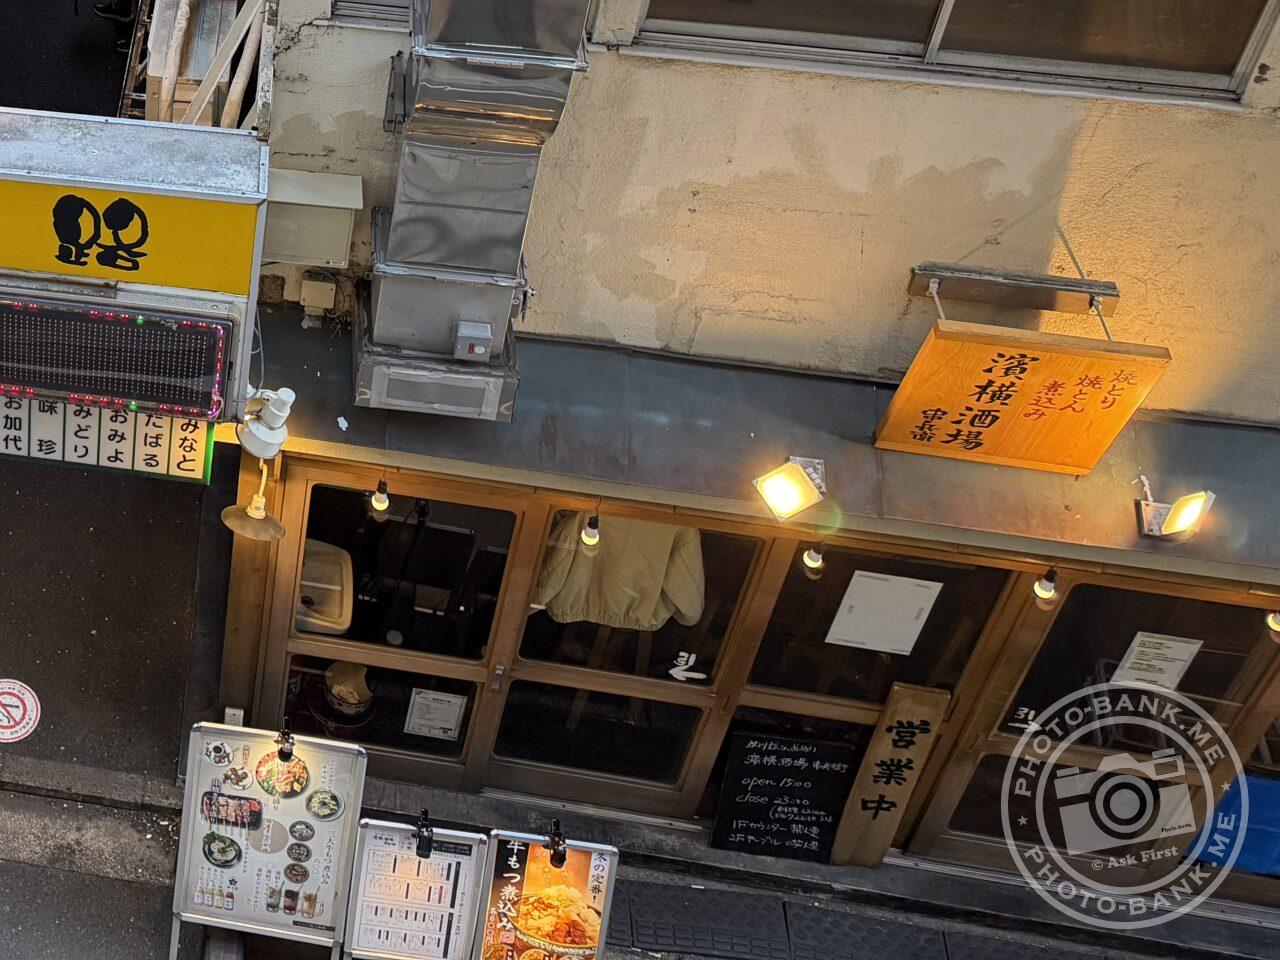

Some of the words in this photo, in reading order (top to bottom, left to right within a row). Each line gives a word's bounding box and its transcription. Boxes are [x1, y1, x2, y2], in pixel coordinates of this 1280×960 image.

[1023, 380, 1067, 422] 煮込み
[1058, 373, 1104, 414] 焼とん
[1100, 368, 1138, 410] 焼とり
[3, 395, 23, 452] お加代
[36, 400, 58, 456] 味珍
[72, 404, 94, 459] みどり
[106, 408, 128, 464] おみよ
[175, 419, 200, 473] みなと
[741, 777, 777, 791] open
[860, 718, 932, 821] 営業中
[736, 792, 769, 803] close
